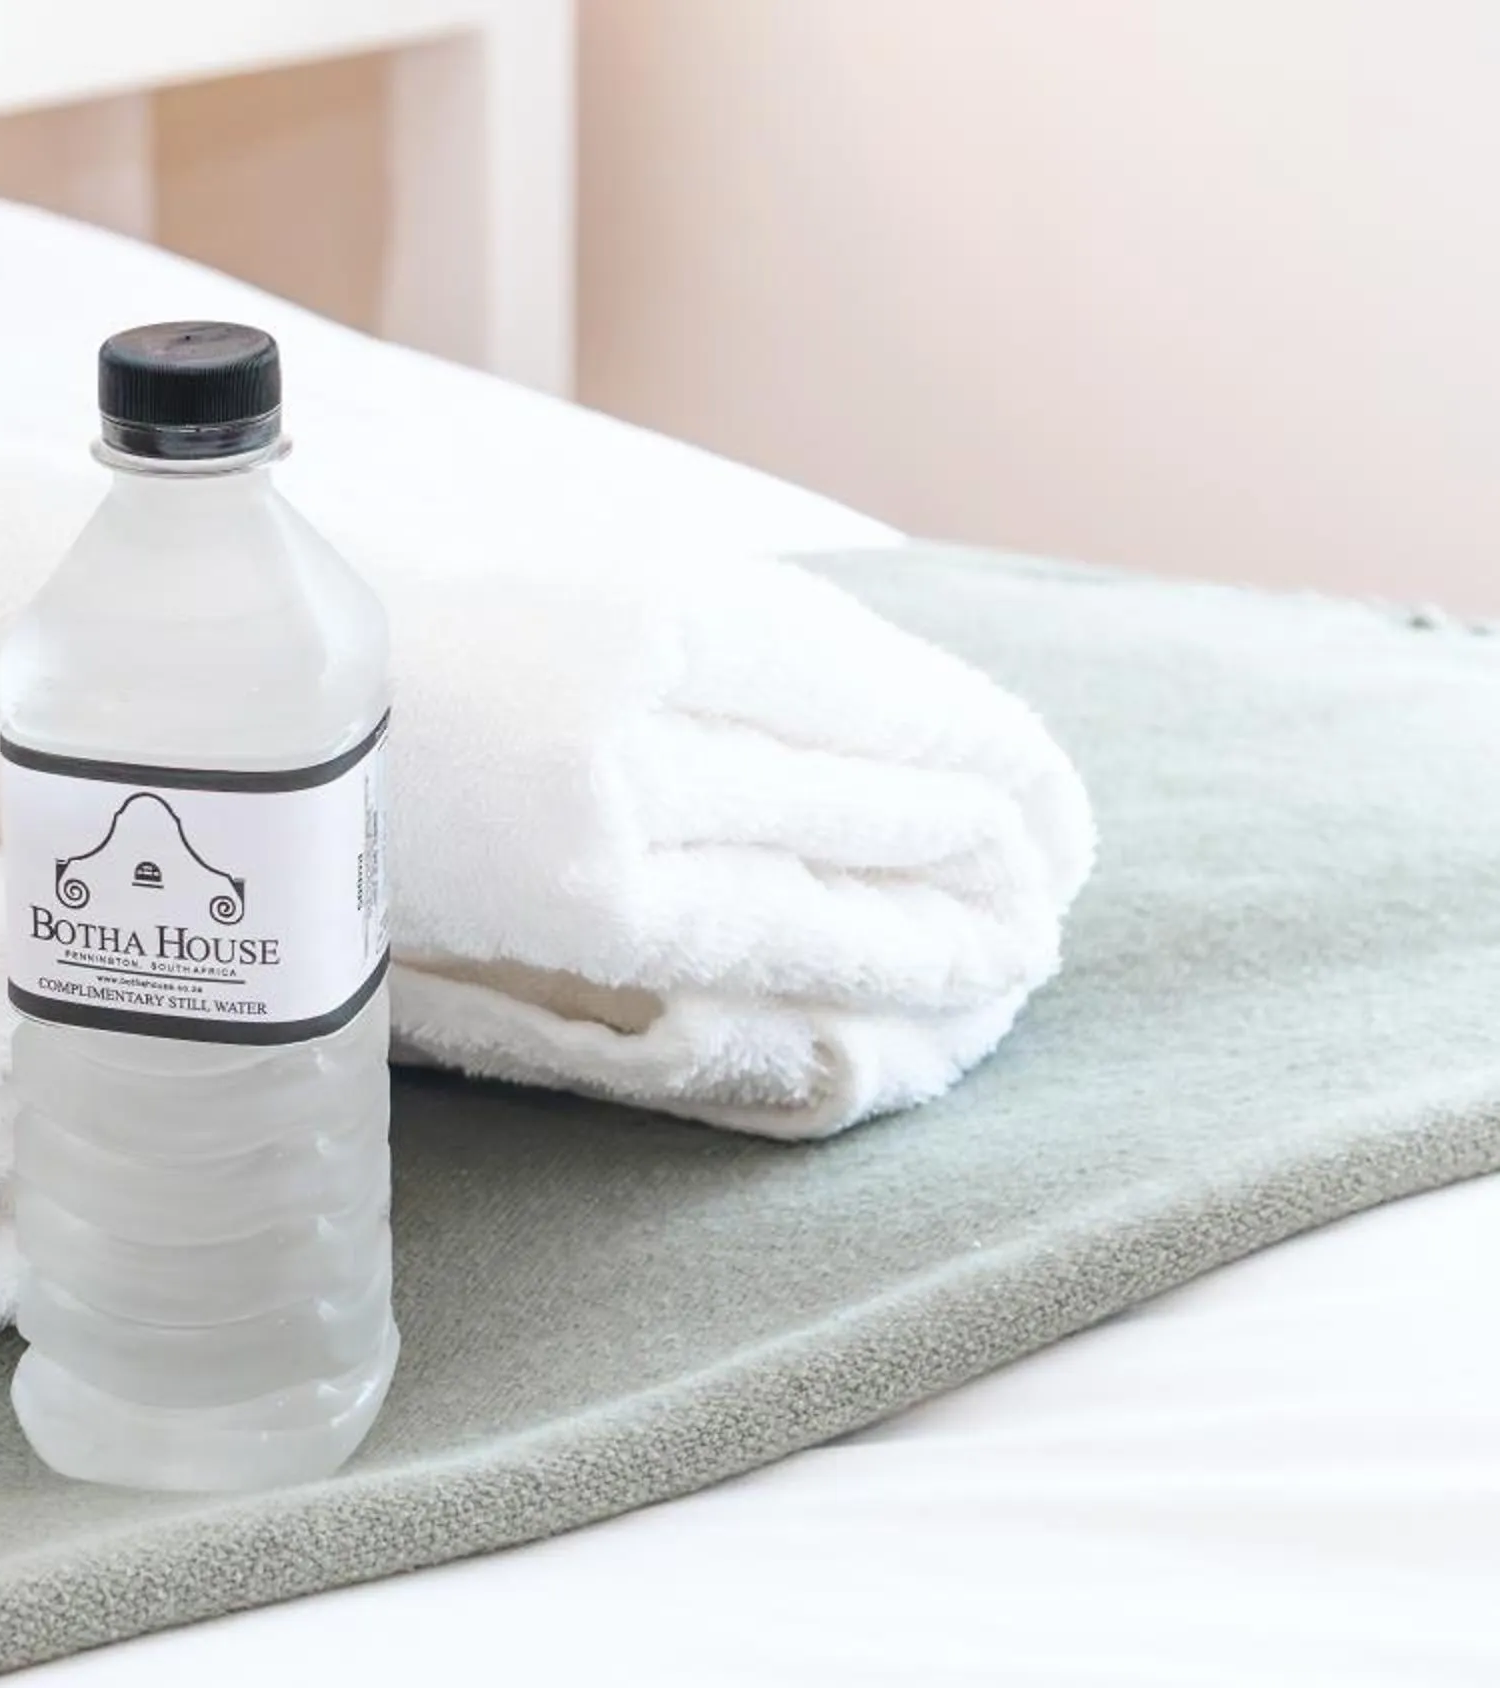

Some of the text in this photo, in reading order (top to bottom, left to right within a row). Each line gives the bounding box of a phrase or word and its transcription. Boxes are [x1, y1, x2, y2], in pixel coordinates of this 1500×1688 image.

[30, 904, 281, 966] BOTHA HOUSE
[38, 976, 268, 1015] COMPLIMENTARY STILL WATER
